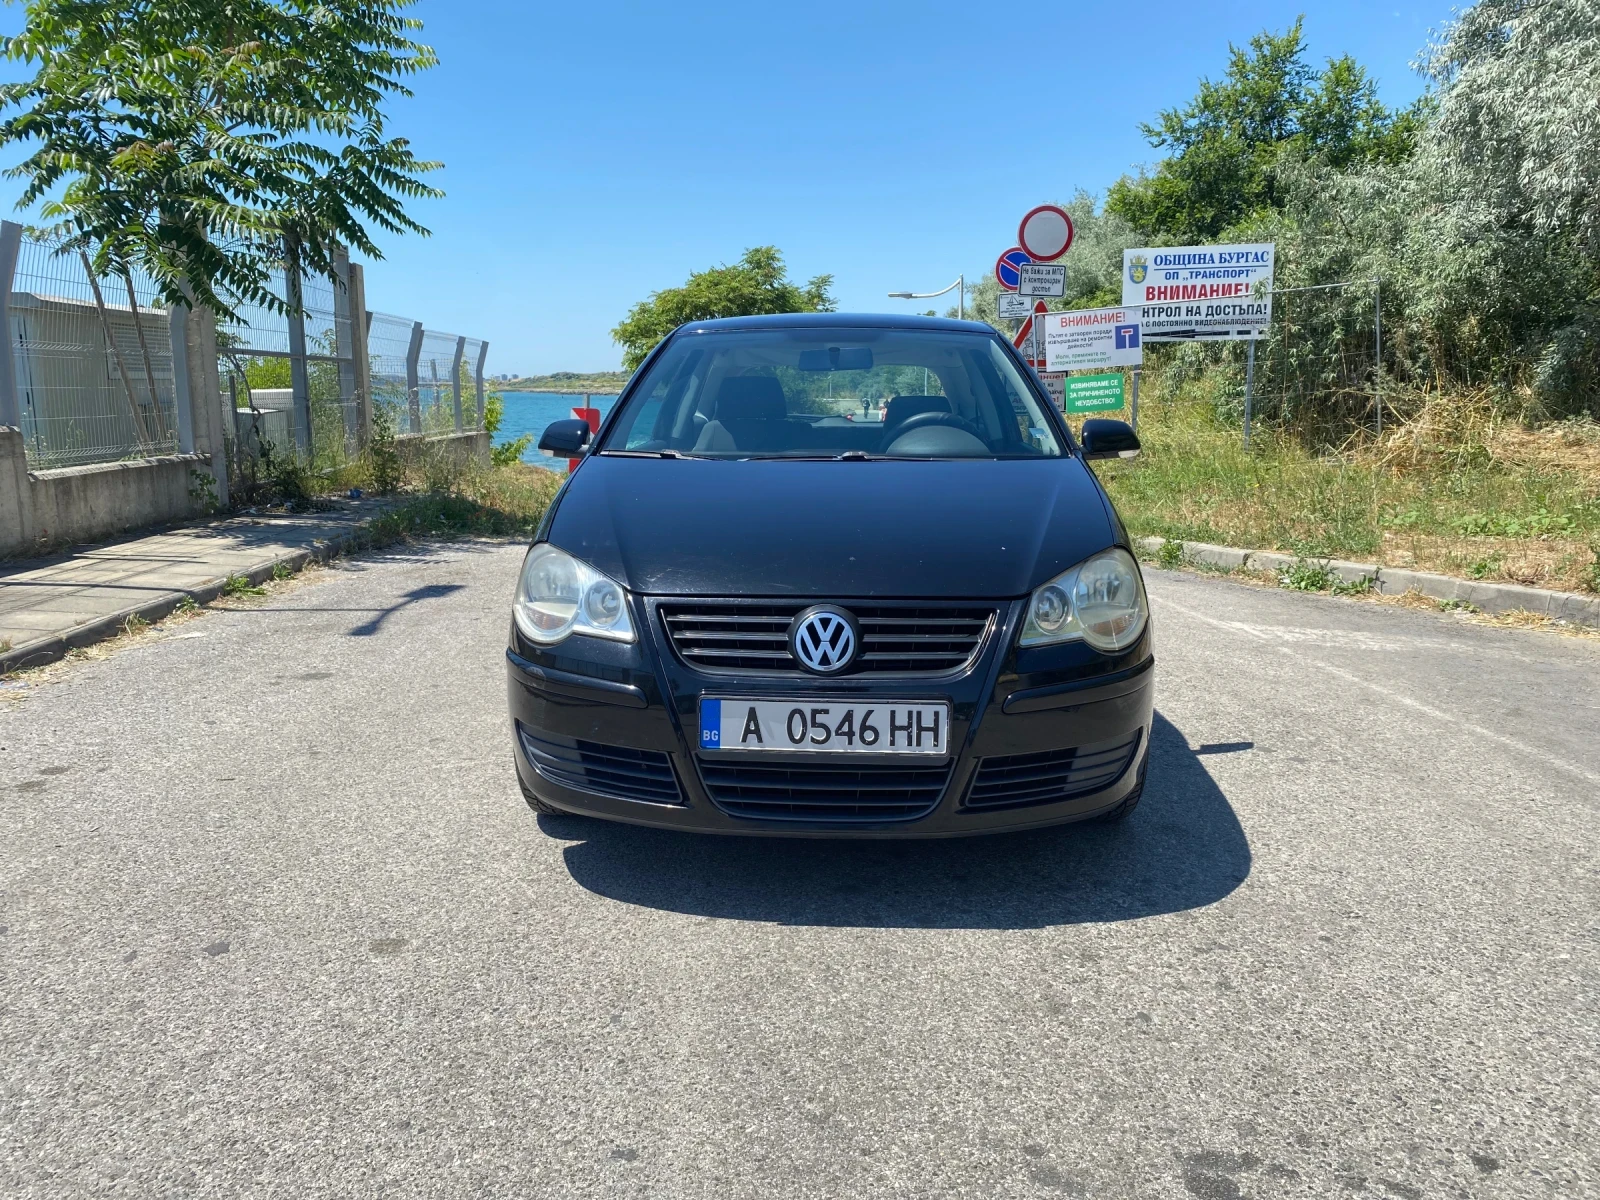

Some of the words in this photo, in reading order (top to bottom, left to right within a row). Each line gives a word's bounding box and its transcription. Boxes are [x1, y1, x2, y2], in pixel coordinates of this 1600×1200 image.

[1154, 253, 1215, 267] ОБЩИНА
[1219, 250, 1269, 264] БУРГАС
[1051, 268, 1063, 276] МПС
[1164, 271, 1179, 280] ОП
[1145, 282, 1250, 301] ВНИМАНИЕ!
[1185, 305, 1202, 317] НА
[1205, 303, 1267, 318] ДОСТЪПА!
[1060, 312, 1126, 328] ВНИМАНИЕ!
[1152, 319, 1193, 328] ПОСТОЯННО
[1194, 317, 1267, 327] ВИДЕОНАБЛЮДЕНИЕ!
[1070, 380, 1109, 390] ИЗВИНЯВАМЕ
[1077, 388, 1121, 397] ПРИЧИНЕНОТО
[1075, 397, 1116, 407] НЕУДОБСТВО!
[786, 708, 880, 746] 0546
[702, 729, 719, 741] BG
